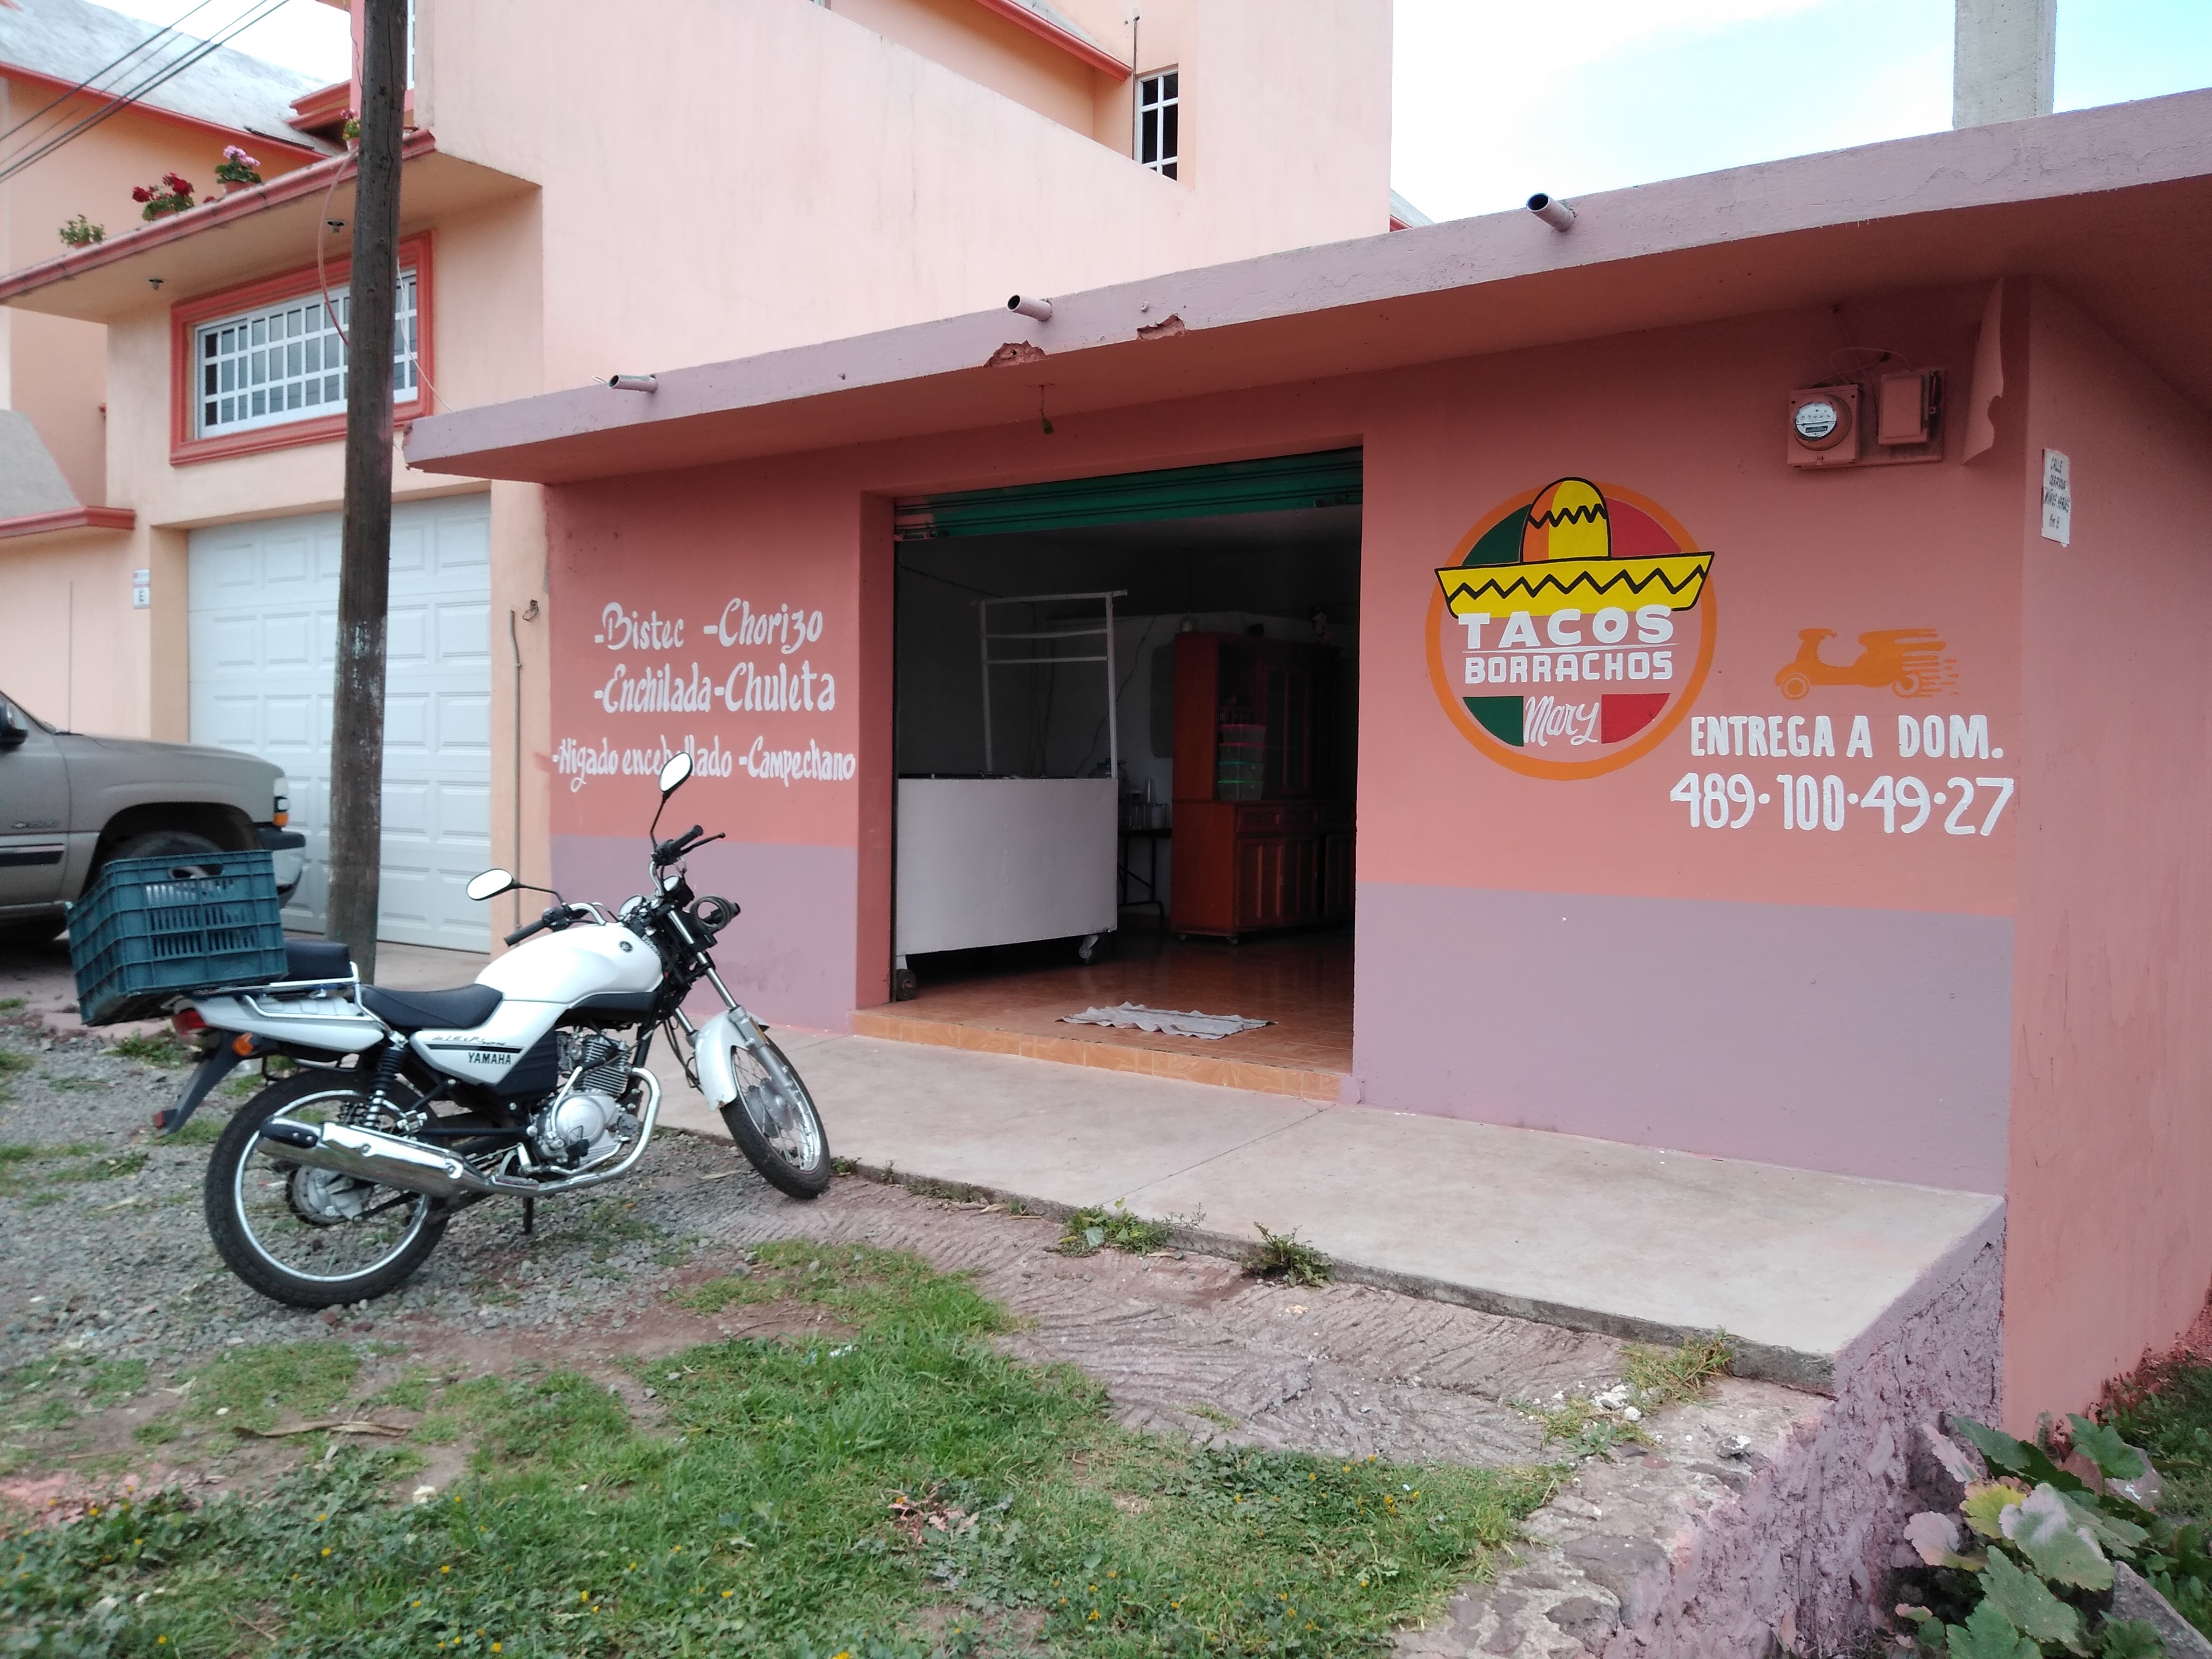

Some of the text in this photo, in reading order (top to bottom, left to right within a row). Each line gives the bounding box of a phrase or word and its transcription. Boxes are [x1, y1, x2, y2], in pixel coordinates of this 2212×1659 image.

[1458, 604, 1674, 649] TACOS
[1465, 651, 1673, 684] BORRACHOS
[1523, 695, 1600, 747] Mary
[1690, 714, 2004, 759] ENTREGA A DOM.
[621, 734, 733, 778] enceblado
[468, 1051, 511, 1065] YAMAHA
